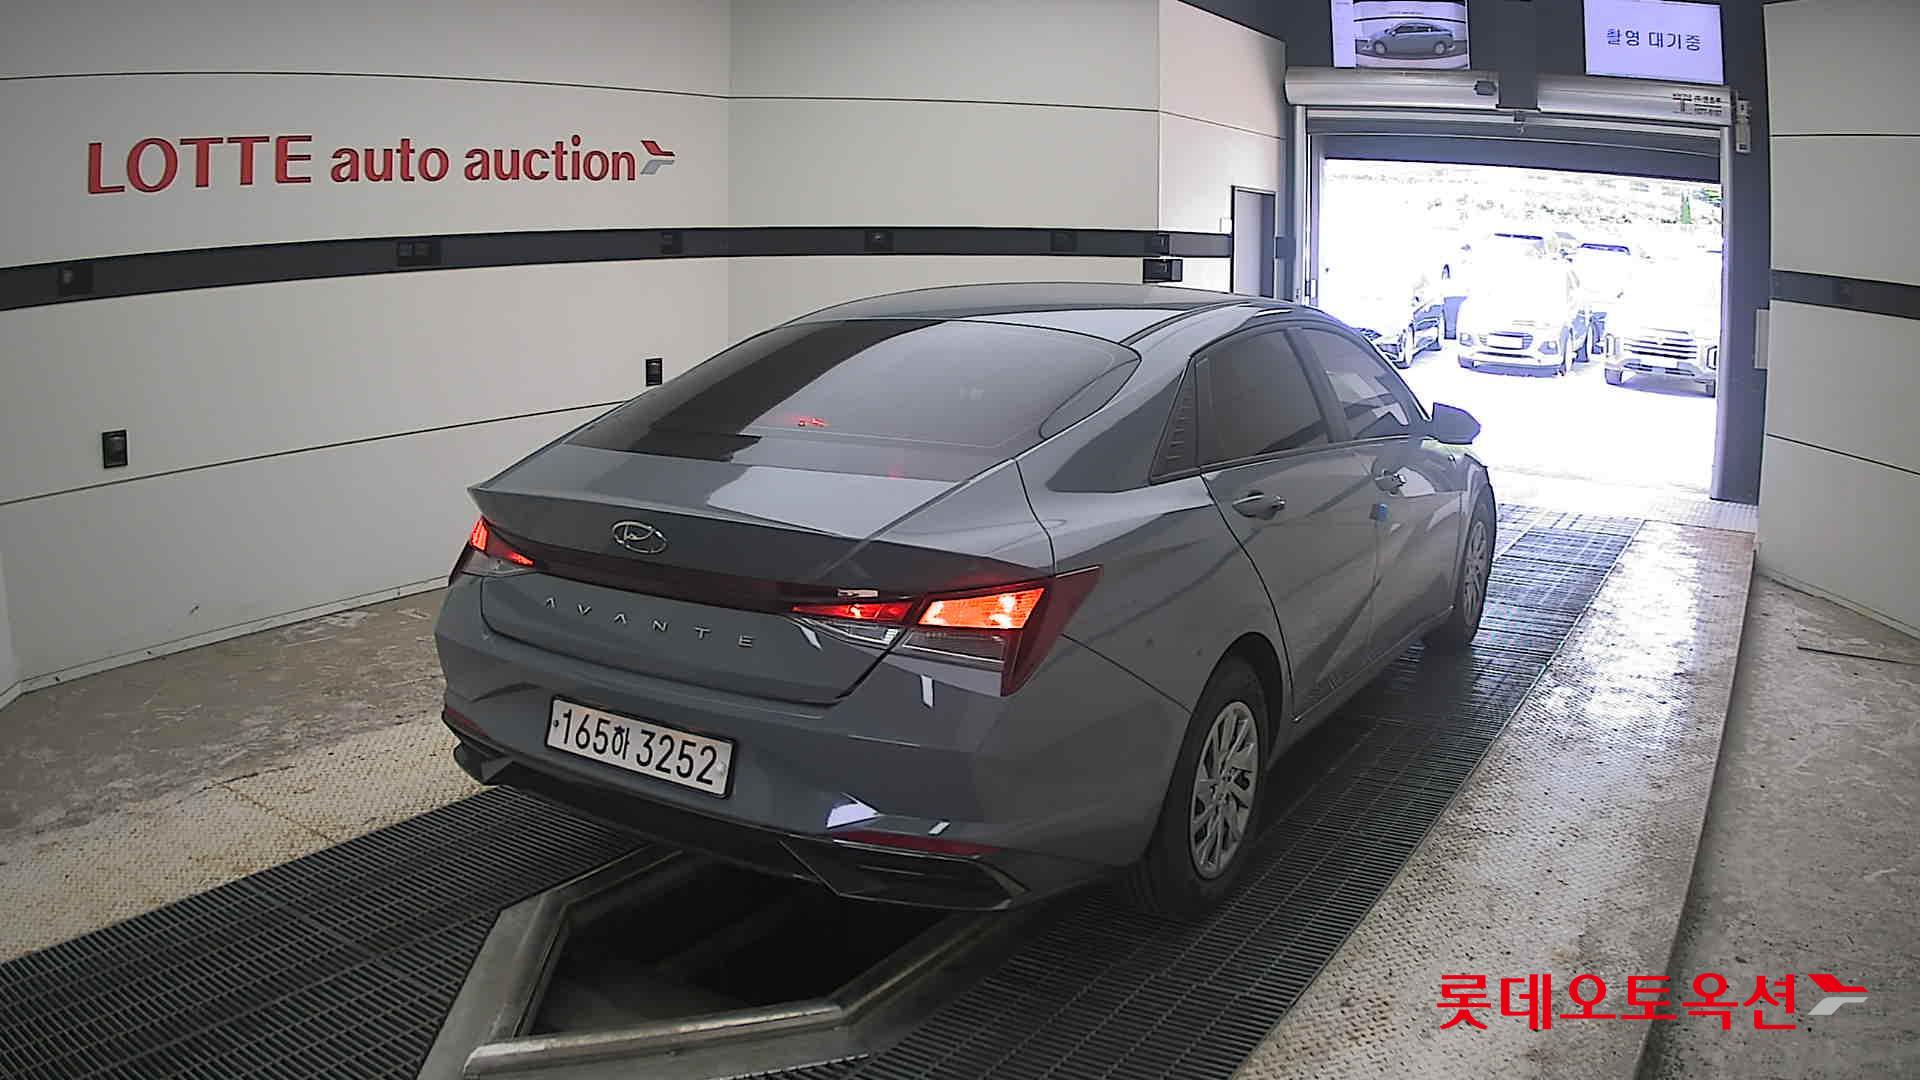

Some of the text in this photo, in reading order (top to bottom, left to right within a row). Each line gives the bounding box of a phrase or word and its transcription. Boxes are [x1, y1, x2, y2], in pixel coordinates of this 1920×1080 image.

[1607, 28, 1701, 52] 촬영 대기중
[87, 134, 637, 195] LOTTE auto auction
[544, 596, 756, 649] AVANTE
